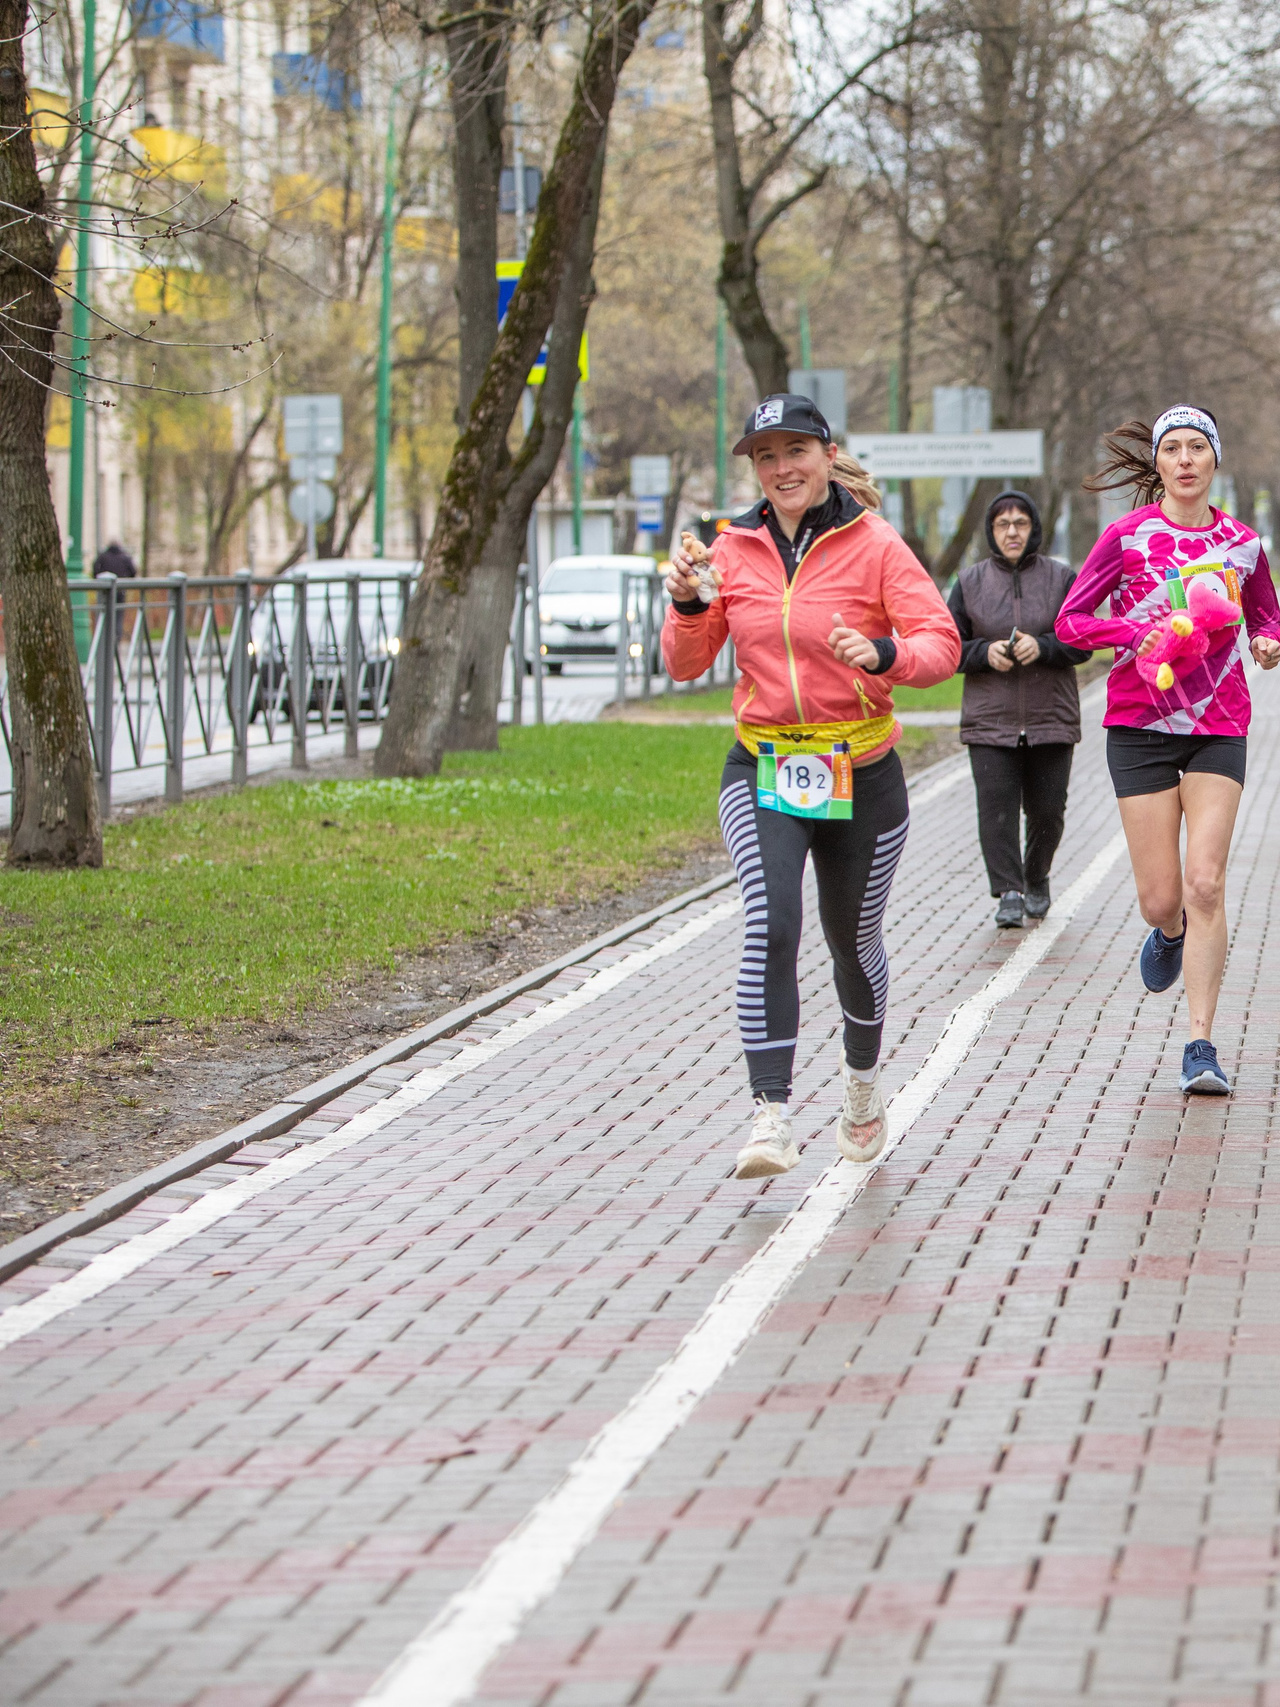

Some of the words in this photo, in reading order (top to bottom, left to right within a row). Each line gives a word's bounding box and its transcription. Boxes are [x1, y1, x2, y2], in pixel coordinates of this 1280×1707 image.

[1163, 410, 1189, 421] grom
[784, 765, 811, 789] 18
[816, 773, 826, 789] 2
